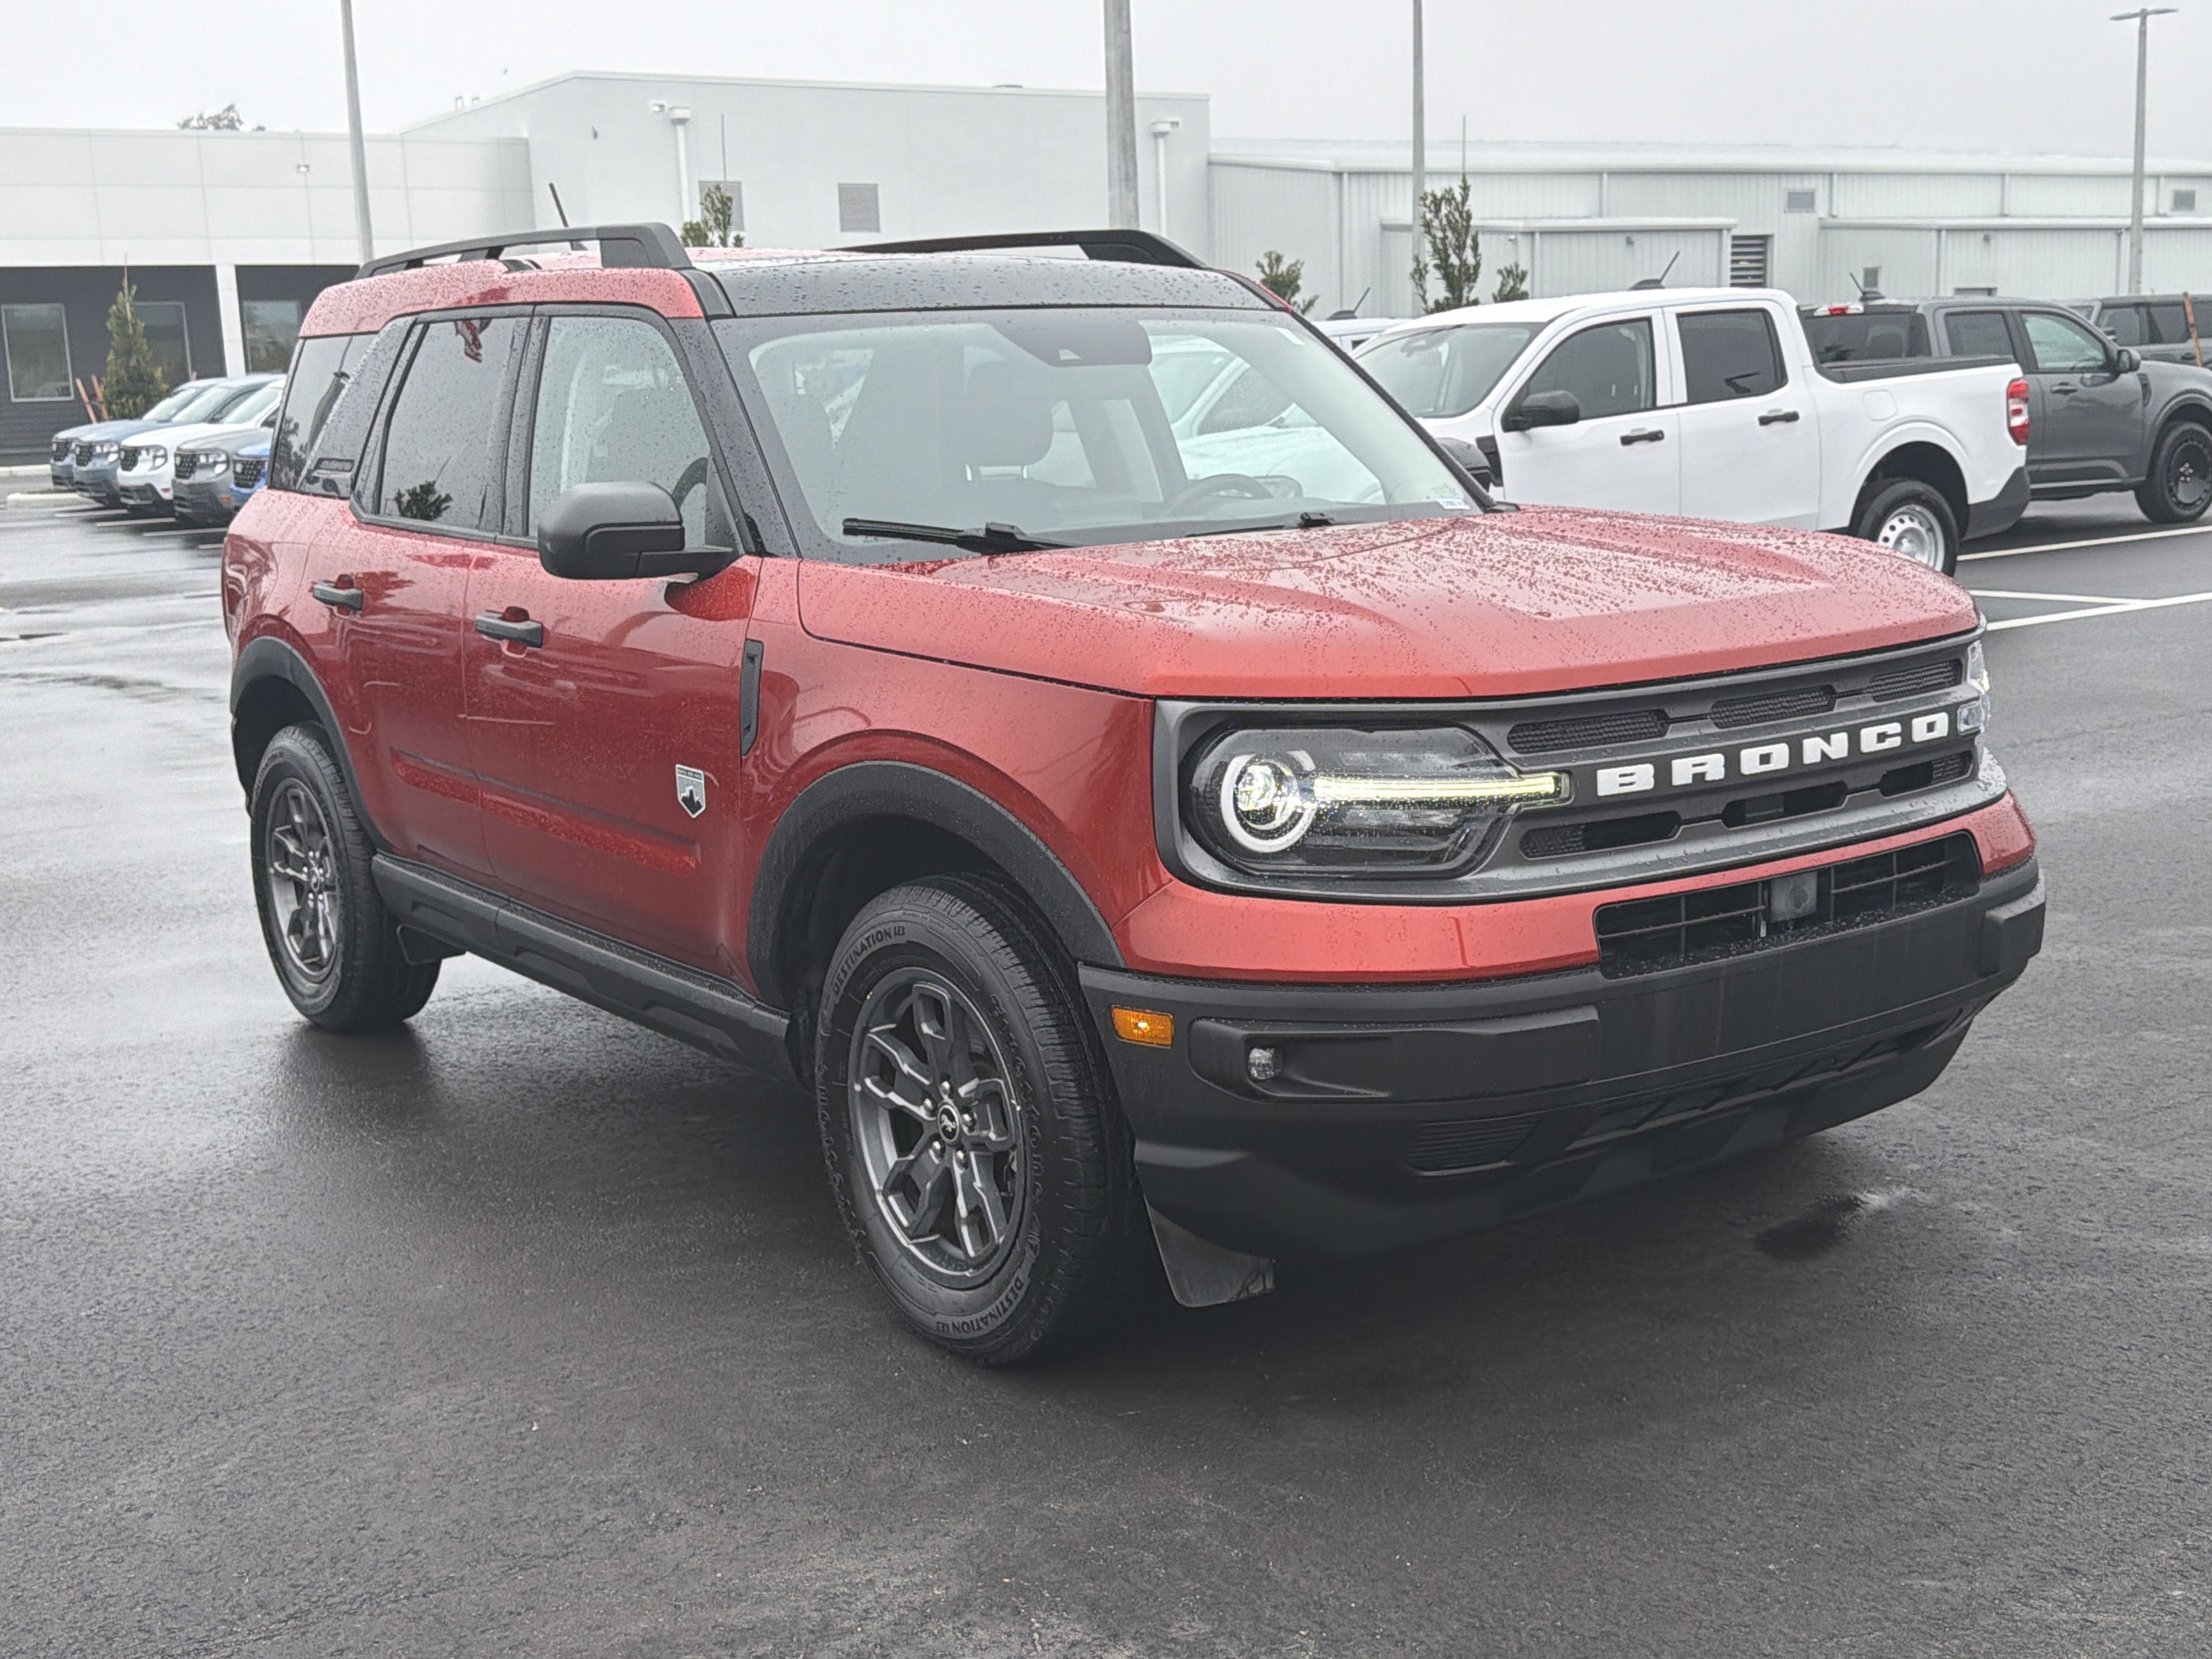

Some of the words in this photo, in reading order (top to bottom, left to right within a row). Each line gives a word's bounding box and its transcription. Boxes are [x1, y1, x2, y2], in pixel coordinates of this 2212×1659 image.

[1596, 712, 1949, 797] BRONCO
[832, 927, 893, 995] DESTINATION
[952, 1275, 1024, 1334] DESTINATION
